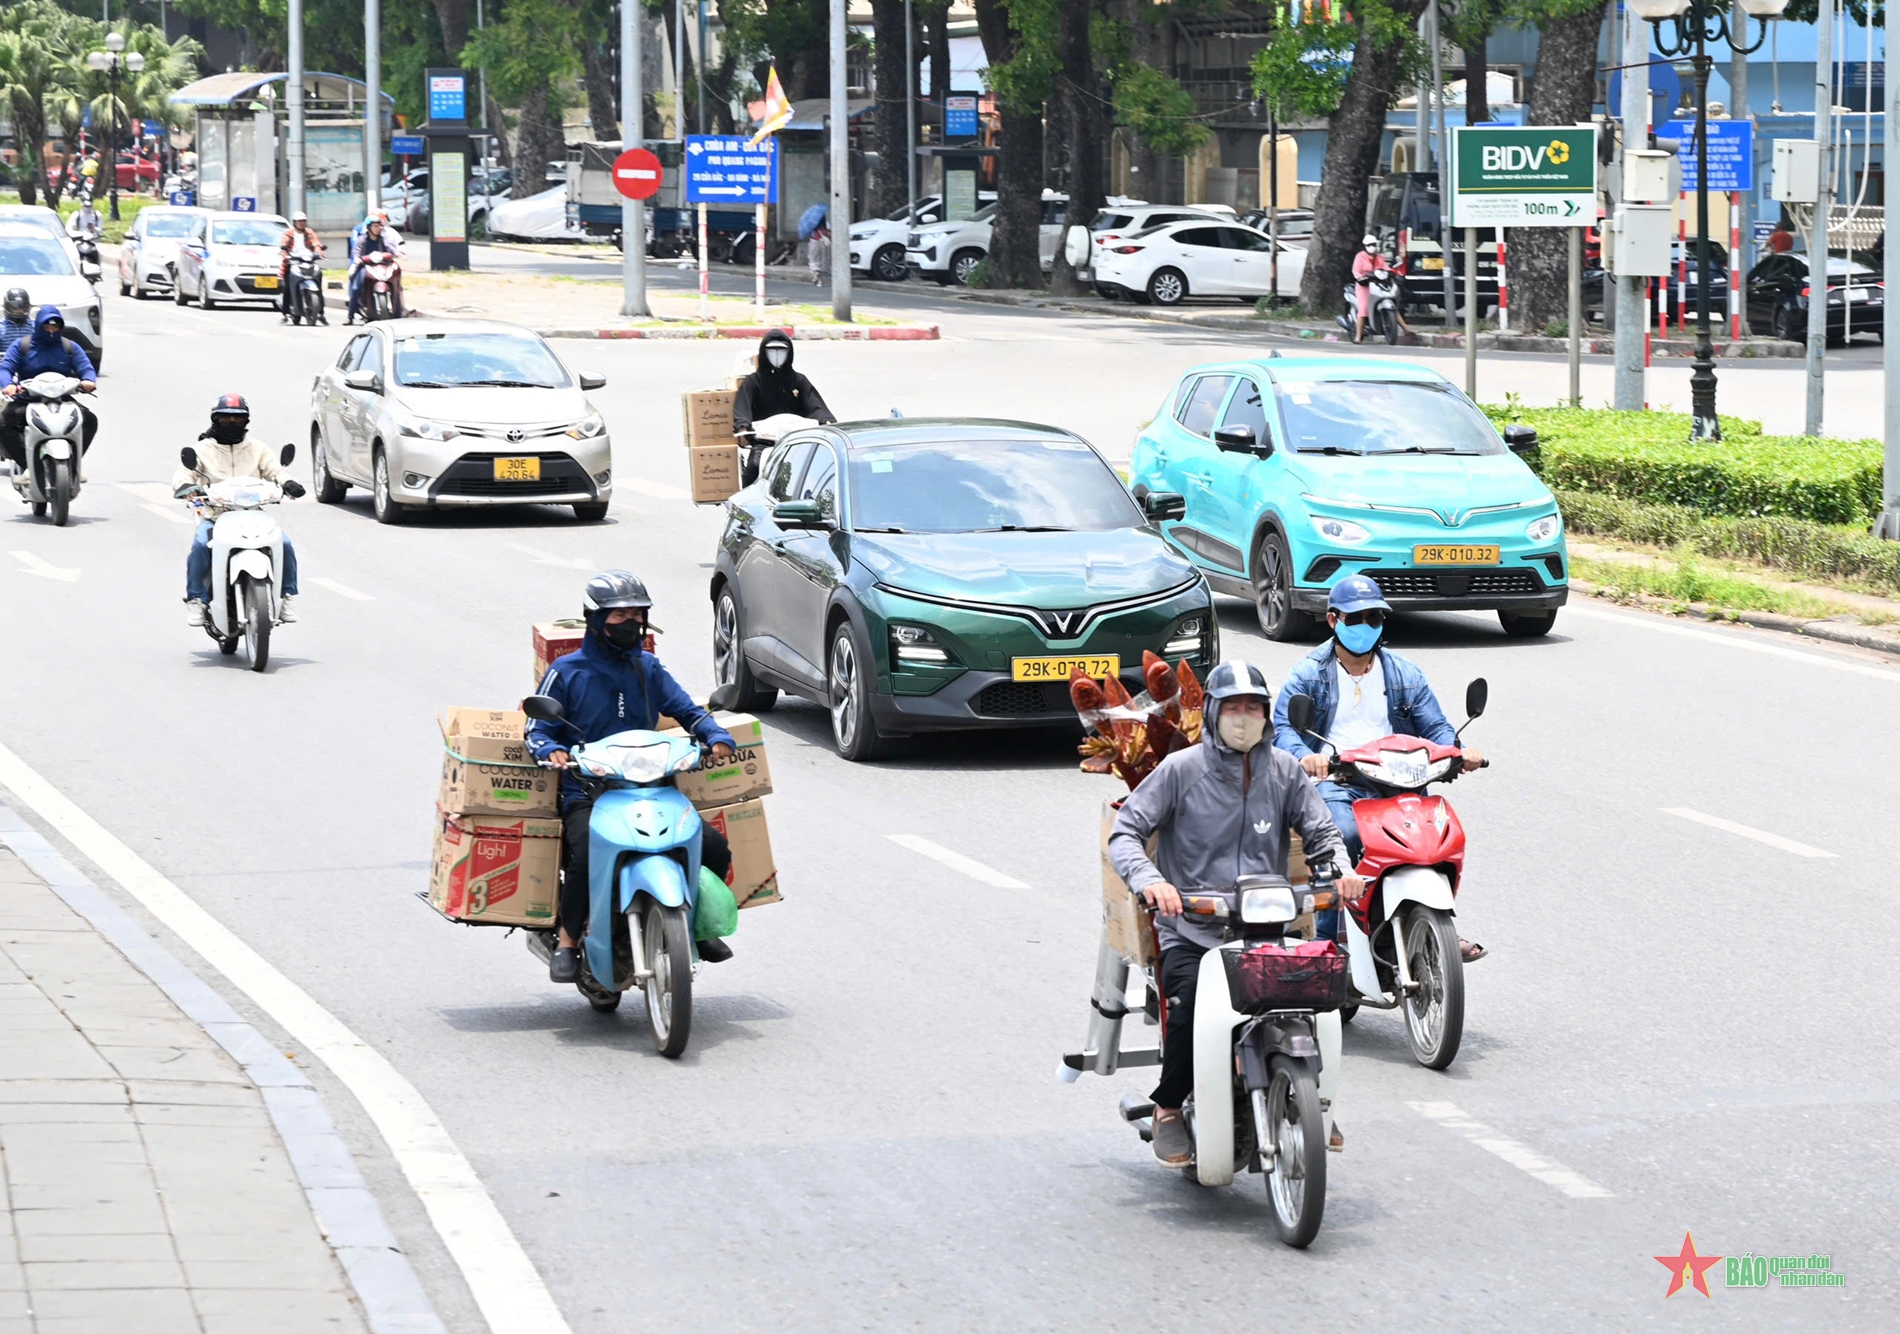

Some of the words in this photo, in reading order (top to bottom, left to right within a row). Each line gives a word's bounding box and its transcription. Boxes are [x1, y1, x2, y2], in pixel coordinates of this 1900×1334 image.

[1482, 146, 1546, 170] BIDV
[508, 459, 527, 469] 30E
[1421, 548, 1492, 561] 29K-010.32
[474, 722, 519, 731] COCONUT
[503, 753, 523, 761] XIM
[728, 748, 756, 765] DỪA
[491, 777, 533, 791] WATER
[477, 842, 507, 859] Light
[469, 880, 489, 915] 3
